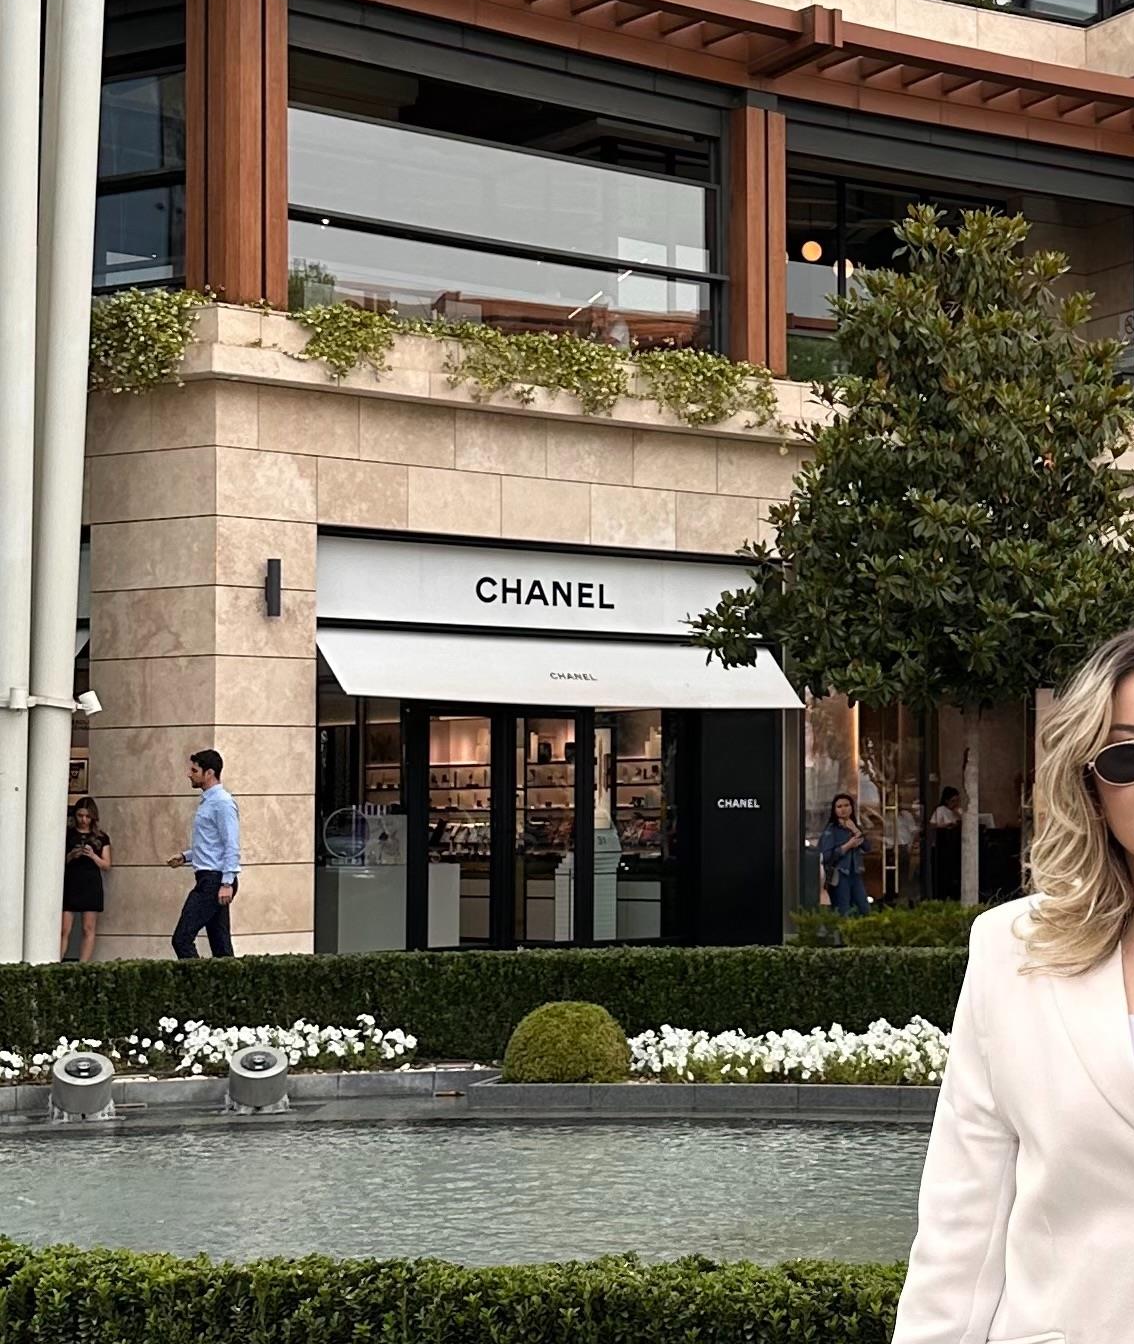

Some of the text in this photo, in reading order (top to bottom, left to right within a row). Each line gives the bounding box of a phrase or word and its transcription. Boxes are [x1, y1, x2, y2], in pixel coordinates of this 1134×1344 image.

[475, 576, 615, 610] CHANEL
[549, 671, 599, 682] CHANEL
[716, 798, 761, 810] CHANEL
